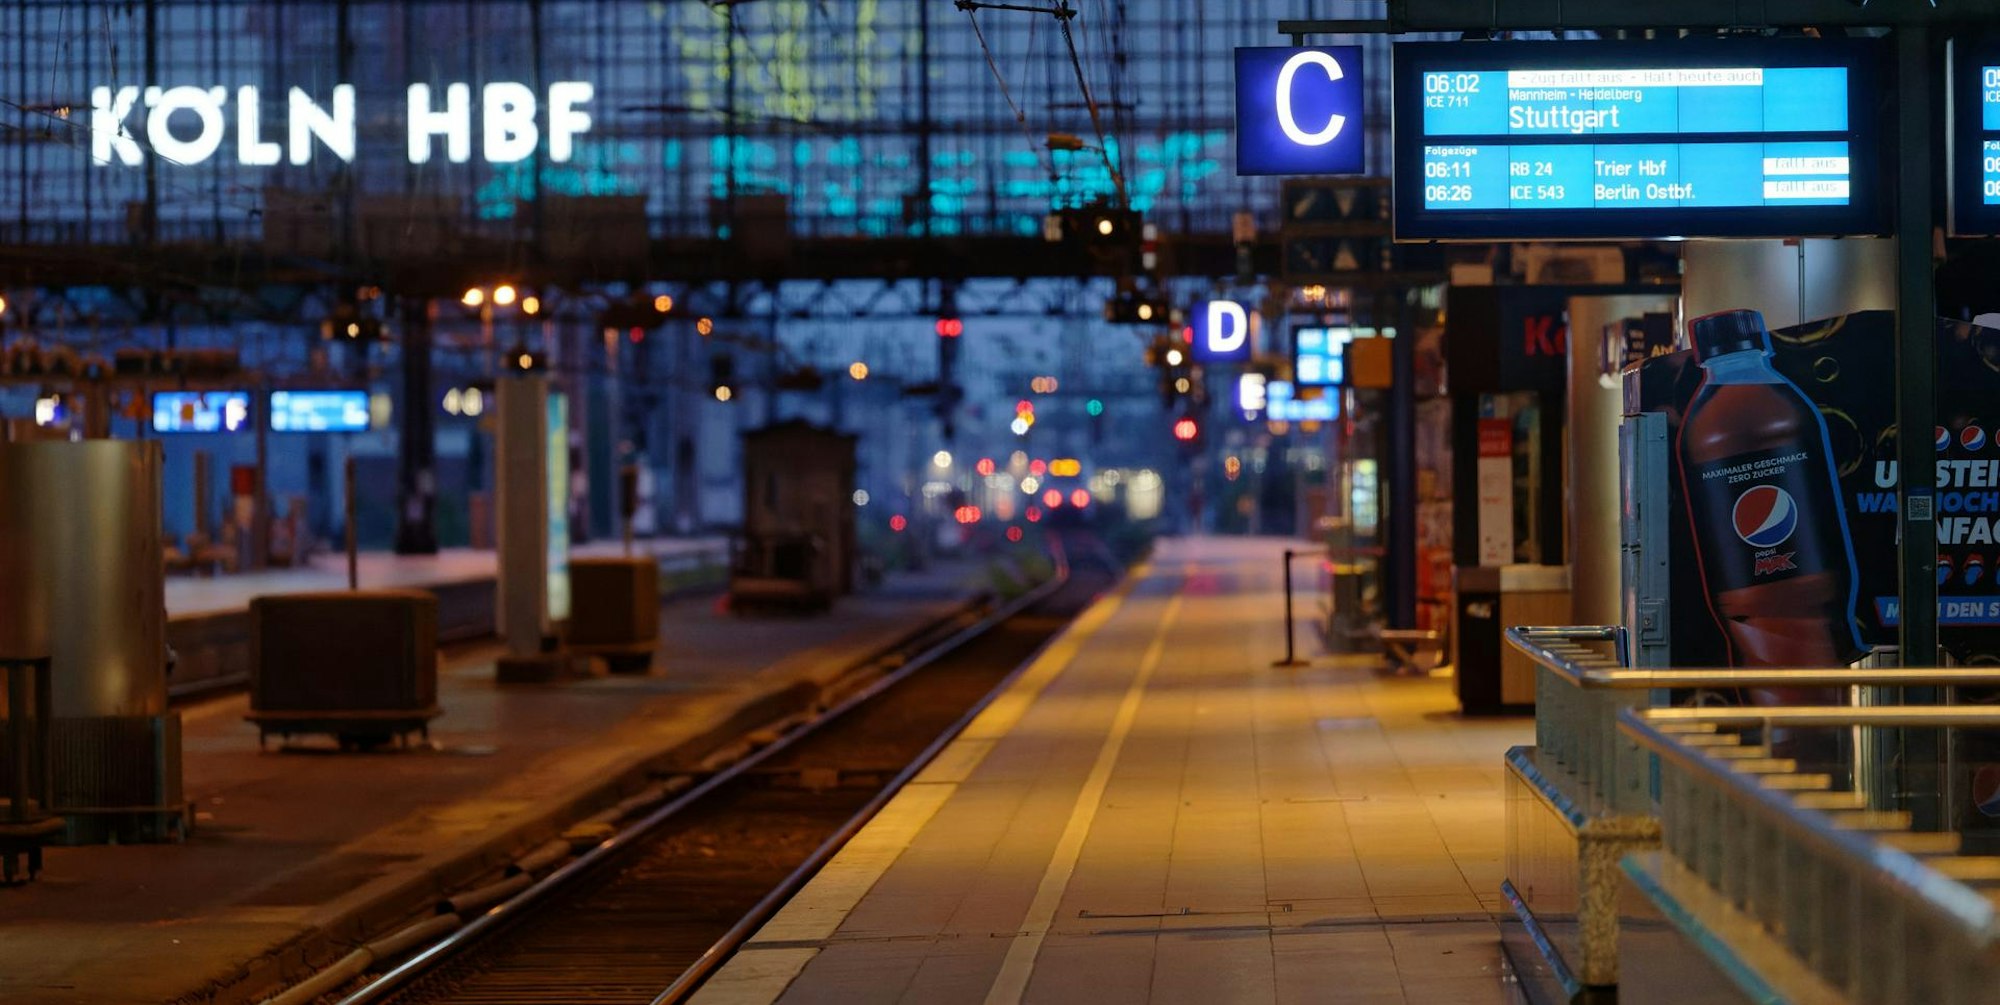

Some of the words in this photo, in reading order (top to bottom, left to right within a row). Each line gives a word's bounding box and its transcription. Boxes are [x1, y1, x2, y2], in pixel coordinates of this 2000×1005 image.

[1426, 74, 1480, 93] 06:02
[1597, 73, 1624, 84] aus
[1678, 71, 1722, 83] heute
[1727, 70, 1761, 82] auch
[1276, 51, 1346, 146] C
[1426, 96, 1446, 108] ICE
[1448, 96, 1470, 108] 711
[1509, 88, 1567, 101] Mannheim
[1578, 88, 1643, 103] Heidelberg
[91, 84, 356, 166] KÖLN
[407, 82, 594, 164] HBF
[1509, 104, 1620, 134] Stuttgart
[1425, 146, 1478, 157] Folgezüge
[1425, 161, 1471, 178] 06:11
[1510, 161, 1530, 176] RB
[1535, 161, 1553, 176] 24
[1595, 160, 1633, 176] Trier
[1638, 160, 1667, 176] Hbf
[1425, 184, 1473, 201] 06:26
[1510, 184, 1533, 200] ICE
[1537, 184, 1565, 200] 543
[1595, 183, 1640, 200] Berlin
[1646, 183, 1696, 200] Ostbf.
[1208, 300, 1248, 352] D
[1702, 463, 1753, 480] MAXIMALER
[1753, 452, 1808, 470] GESCHMACK
[1728, 473, 1752, 484] ZERO
[1752, 465, 1786, 479] ZUCKER
[1754, 547, 1777, 559] pepsi
[1946, 602, 1985, 618] DEN
